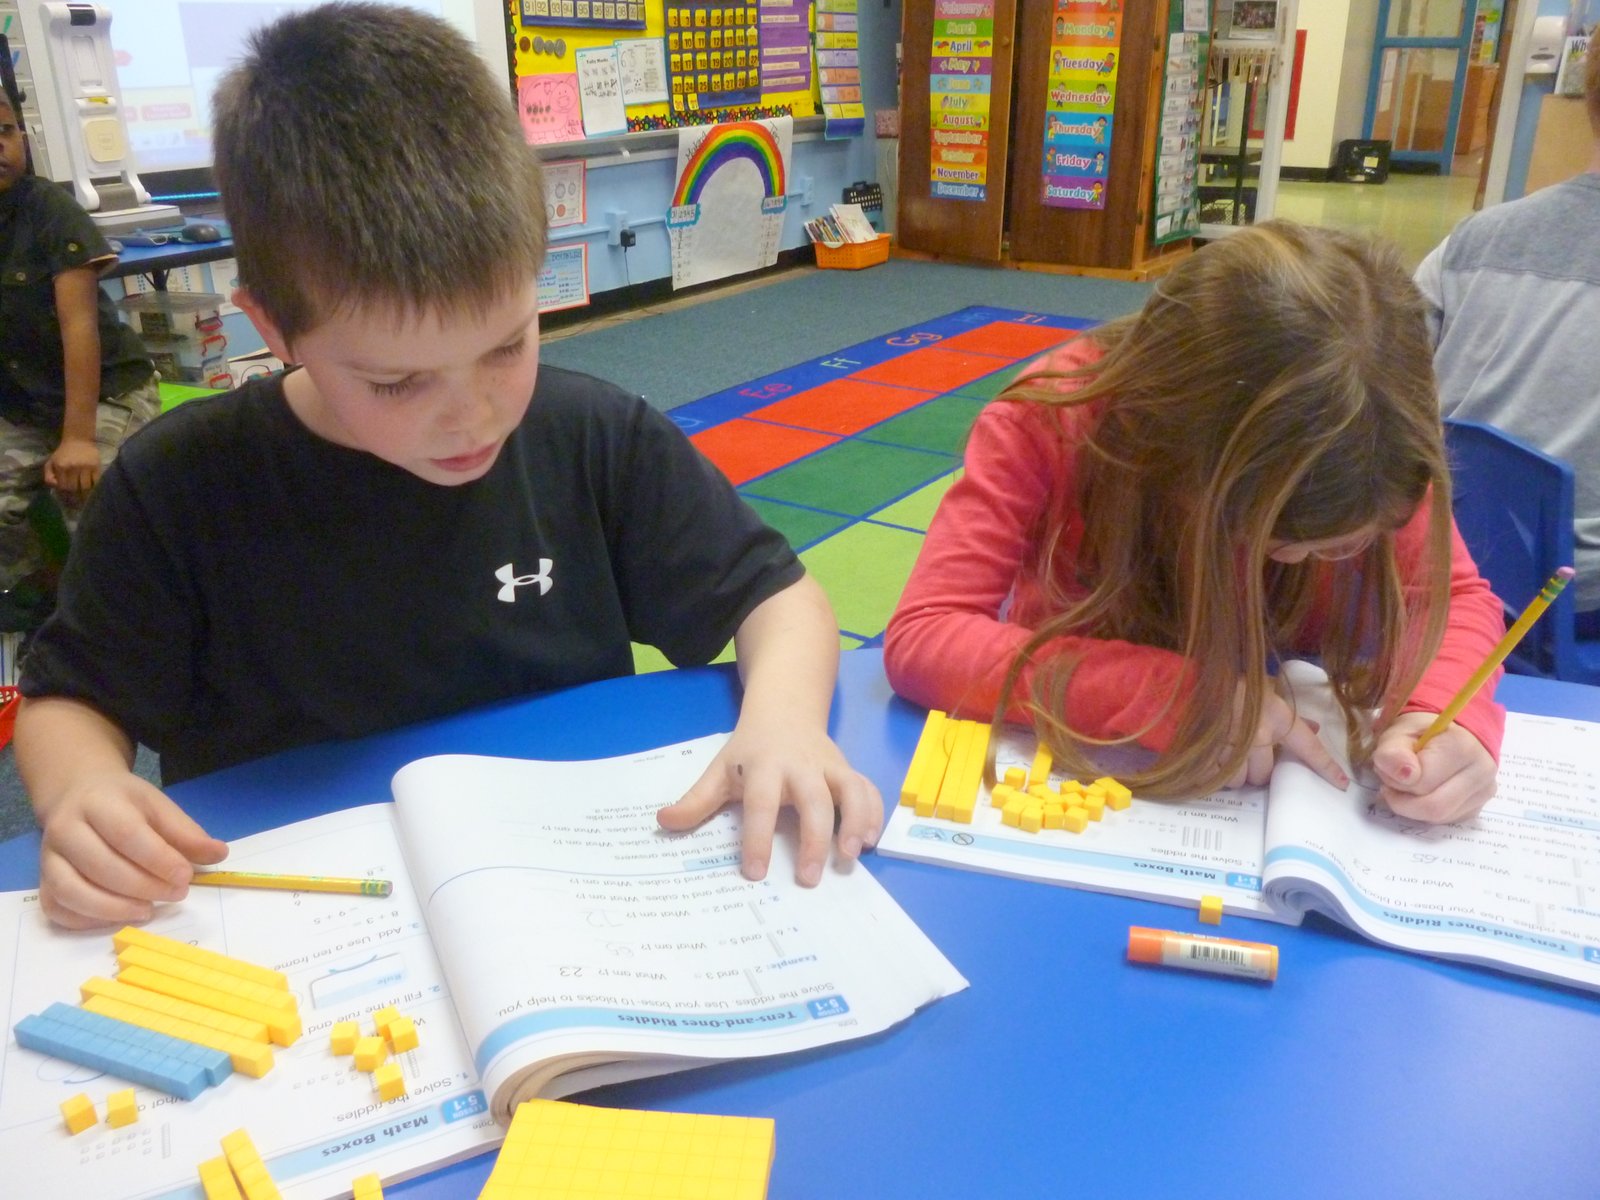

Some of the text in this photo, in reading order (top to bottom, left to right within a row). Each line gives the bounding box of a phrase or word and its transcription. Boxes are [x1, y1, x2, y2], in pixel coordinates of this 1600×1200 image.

[946, 22, 976, 34] March
[1064, 23, 1108, 38] Monday
[950, 40, 972, 53] April
[948, 58, 971, 73] May
[1061, 58, 1104, 72] Tuesday
[949, 96, 968, 108] July
[1051, 90, 1111, 105] Wednesday
[943, 114, 974, 127] August
[1052, 122, 1101, 138] Thursday
[1056, 154, 1091, 170] Friday
[937, 168, 979, 180] November
[938, 182, 979, 197] December
[1047, 185, 1095, 202] Saturday
[886, 332, 943, 347] Gg
[821, 357, 862, 370] Ff
[740, 383, 793, 399] Ee
[1208, 812, 1238, 824] What
[572, 826, 601, 834] What
[584, 839, 613, 848] What
[1478, 838, 1508, 850] What
[660, 851, 677, 859] the
[680, 848, 700, 856] find
[1148, 846, 1242, 866] Solve the riddles.
[698, 854, 738, 866] Try This
[1132, 861, 1216, 880] Math Boxes
[1478, 864, 1510, 876] What
[602, 869, 736, 888] longs and cubes. What
[608, 883, 744, 903] longs and cubes. What
[1421, 879, 1531, 906] and What
[660, 902, 744, 918] and What
[1393, 900, 1444, 913] base-10
[1448, 904, 1476, 915] your
[1479, 912, 1504, 923] Use
[376, 926, 402, 940] Add.
[1382, 910, 1568, 952] Tens-and-Ones Riddles
[1560, 928, 1580, 940] the
[346, 935, 371, 948] Use
[740, 933, 762, 944] and
[676, 942, 707, 950] What
[312, 948, 332, 959] ten
[558, 966, 584, 978] 23
[612, 954, 818, 981] Example: and What am
[494, 982, 835, 1017] Solve the riddles. Use your base-10 blocks to help you.
[306, 990, 422, 1034] Fill the rule and
[618, 1010, 796, 1028] Tens-and-Ones Riddles
[414, 1077, 452, 1096] Solve
[331, 1100, 383, 1123] riddles.
[472, 1120, 494, 1131] Date
[321, 1114, 430, 1158] Math Boxes
